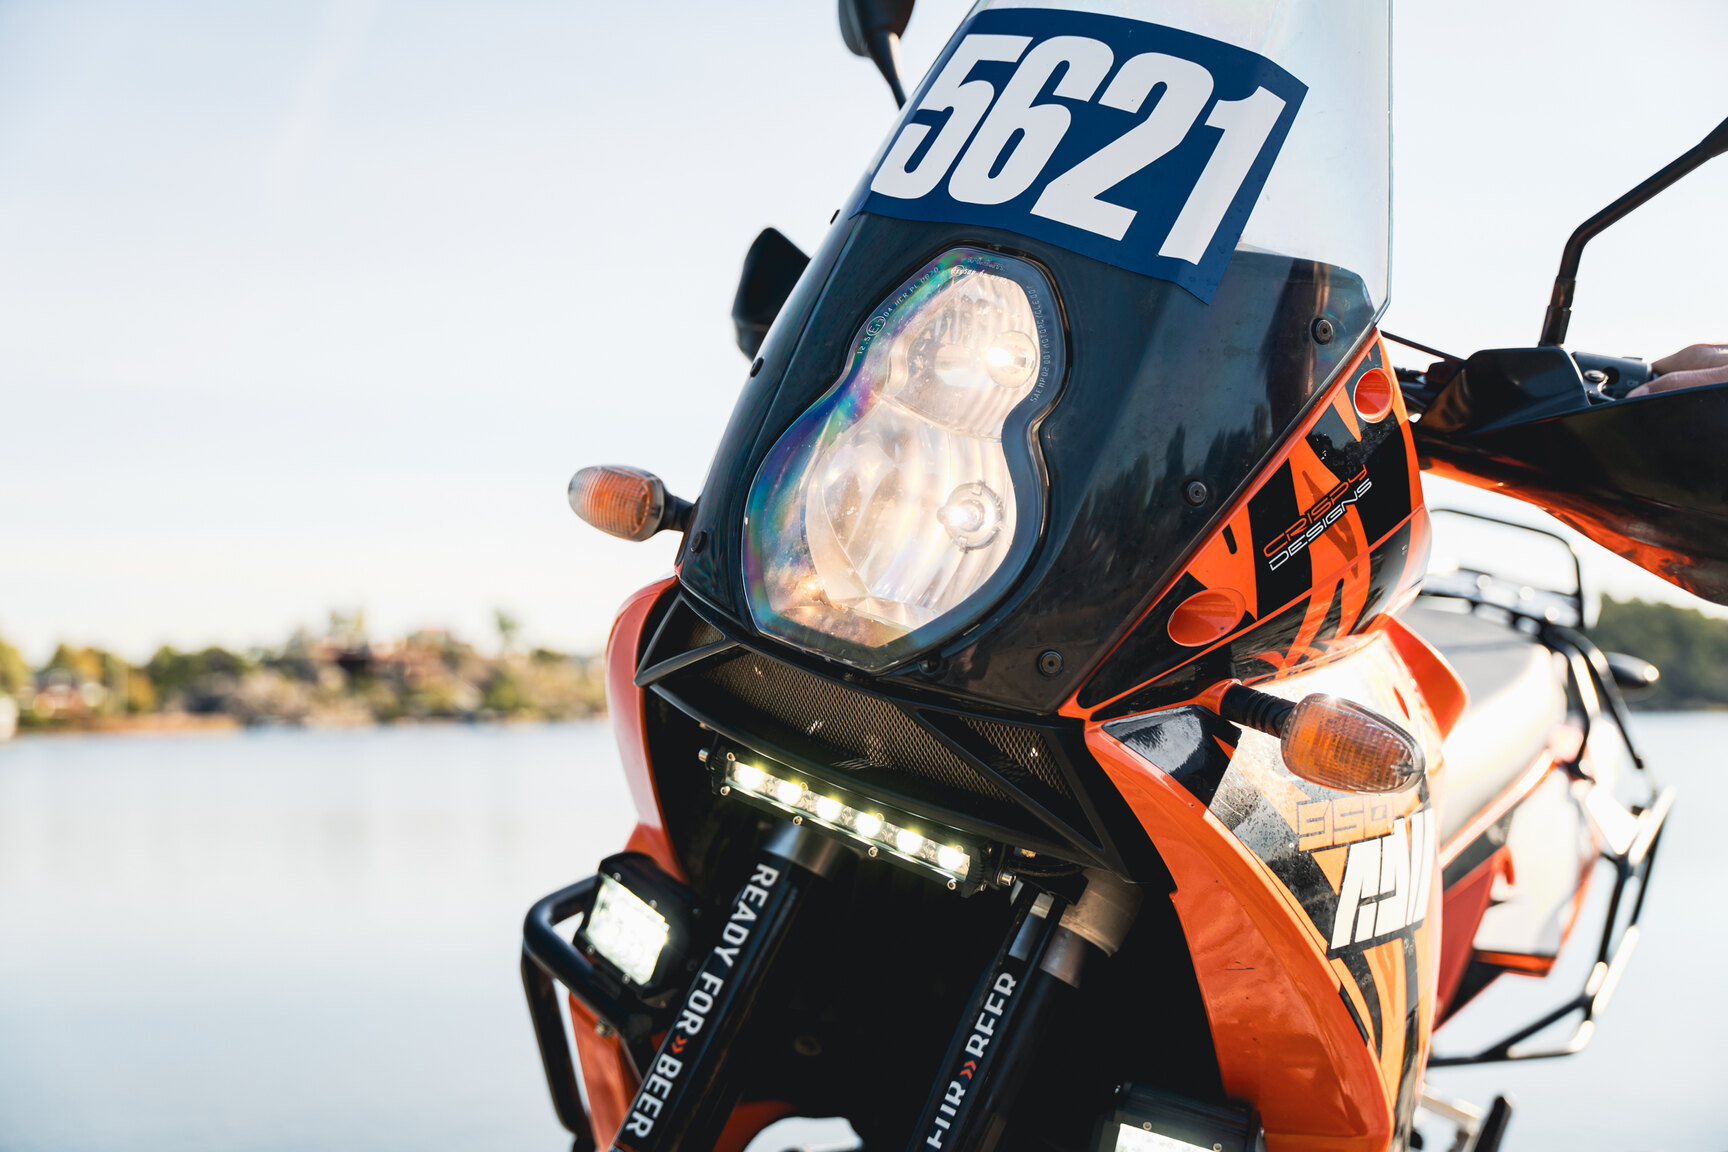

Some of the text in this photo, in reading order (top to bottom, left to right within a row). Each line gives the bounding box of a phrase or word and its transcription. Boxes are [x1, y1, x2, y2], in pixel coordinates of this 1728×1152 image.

[870, 34, 1287, 265] 5621
[1263, 464, 1368, 558] CRISPY
[1268, 478, 1373, 571] DESIGNS
[625, 863, 780, 1139] READY FOR BEER
